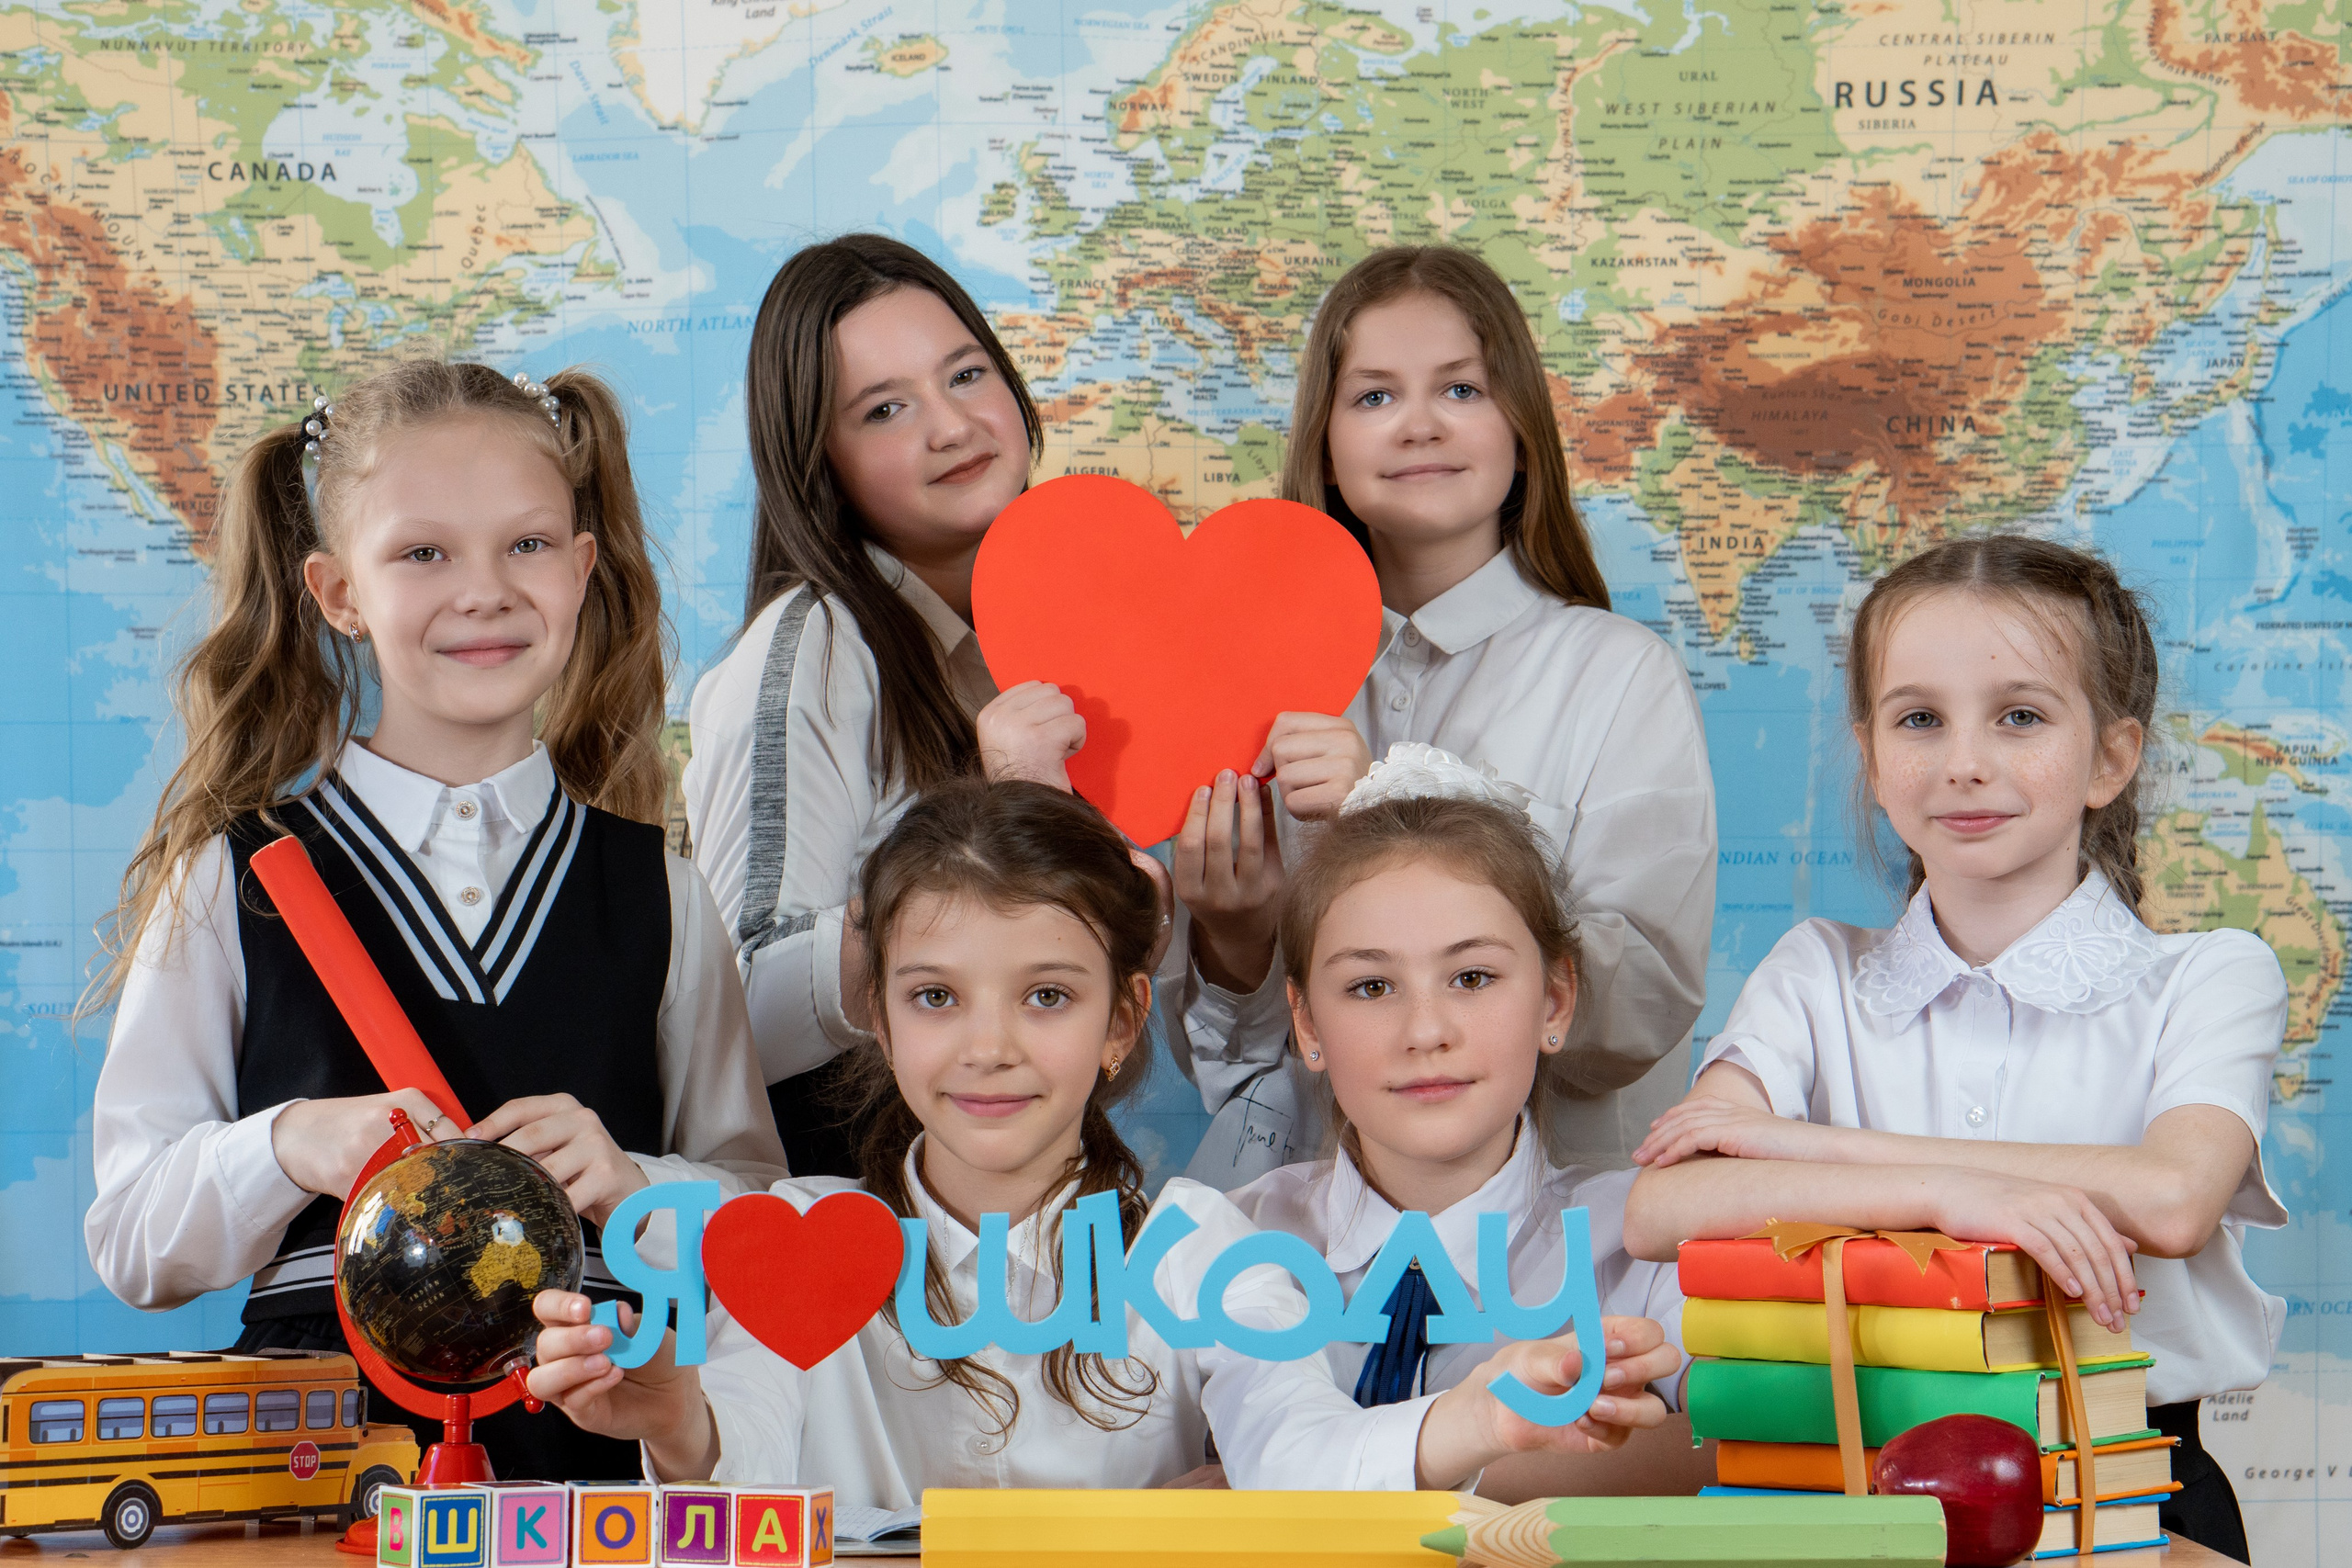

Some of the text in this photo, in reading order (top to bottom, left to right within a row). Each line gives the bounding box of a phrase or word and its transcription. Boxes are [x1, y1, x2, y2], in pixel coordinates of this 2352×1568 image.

[745, 8, 776, 19] Land
[808, 6, 894, 69] Denmark Strait
[1879, 33, 2055, 47] CENTRAL SIBERIN
[2205, 30, 2278, 44] FAR EAST
[100, 39, 308, 53] NUNNAVUT TERRITORY
[1193, 28, 1285, 67] SCANDINAVIA
[890, 53, 927, 62] ICELAND
[1923, 54, 2009, 67] PLATEAU
[1182, 72, 1240, 84] SWEDEN
[1258, 73, 1318, 85] FINLAND
[1679, 71, 1718, 82] URAL
[569, 59, 611, 126] Davis Strait
[1833, 79, 1999, 109] RUSSIA
[1108, 101, 1167, 111] NORWAY
[1450, 99, 1487, 109] WEST
[1605, 101, 1777, 116] WEST SIBERIAN
[1858, 119, 1917, 130] SIBERIA
[1657, 138, 1723, 150] PLAIN
[208, 161, 337, 182] CANADA
[1462, 198, 1508, 209] VOLGA
[460, 204, 487, 270] Quebec
[1205, 227, 1250, 236] POLAND
[1283, 256, 1342, 267] UKRAINE
[1589, 256, 1679, 268] KAZAKHSTAN
[1059, 278, 1108, 290] FRANCE
[1902, 276, 1977, 288] MONGOLIA
[1149, 317, 1185, 328] ITALY
[1877, 308, 1996, 328] Gobi Desert
[627, 318, 693, 334] NORTH
[1019, 355, 1057, 365] SPAIN
[2206, 358, 2245, 369] JAPAN
[104, 383, 211, 402] UNITED
[1749, 410, 1829, 423] HIMALAYA
[1884, 414, 1977, 434] CHINA
[1063, 467, 1120, 478] ALGERIA
[1203, 472, 1241, 483] LIBYA
[169, 501, 217, 512] MEXIC
[1700, 536, 1765, 550] INDIA
[2213, 660, 2304, 672] Caroline
[2276, 745, 2318, 755] PAPUA
[2256, 756, 2340, 767] NEW GUINEA
[1718, 851, 1853, 866] NDIAN OCEAN
[591, 1179, 720, 1369] Я
[2208, 1393, 2255, 1405] Adelie
[2212, 1409, 2250, 1422] Land
[292, 1453, 318, 1469] STOP
[2245, 1466, 2315, 1482] George
[2327, 1464, 2337, 1477] V
